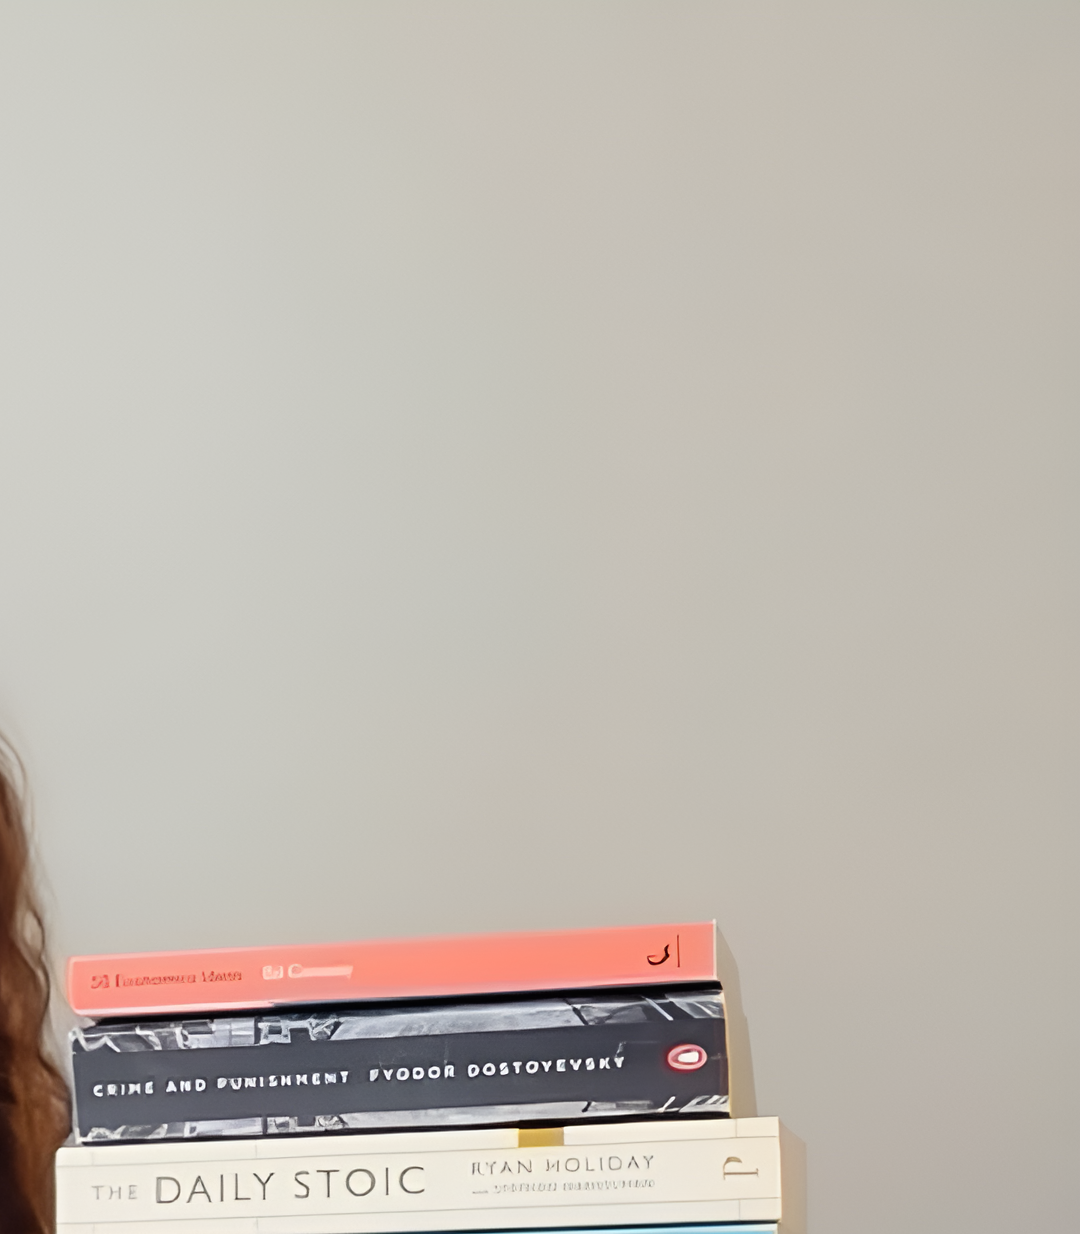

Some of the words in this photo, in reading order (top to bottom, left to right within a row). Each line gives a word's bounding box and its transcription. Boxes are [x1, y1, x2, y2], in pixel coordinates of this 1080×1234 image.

[467, 1056, 625, 1079] DOSTOYEVSKY
[93, 1080, 154, 1098] CRIME
[166, 1078, 206, 1094] AND
[217, 1070, 349, 1091] PUNISHMENT
[471, 1159, 533, 1176] RYAN
[545, 1154, 655, 1174] HOLIDAY
[91, 1184, 138, 1201] THE
[155, 1171, 275, 1204] DAILY
[294, 1165, 426, 1199] STOIC
